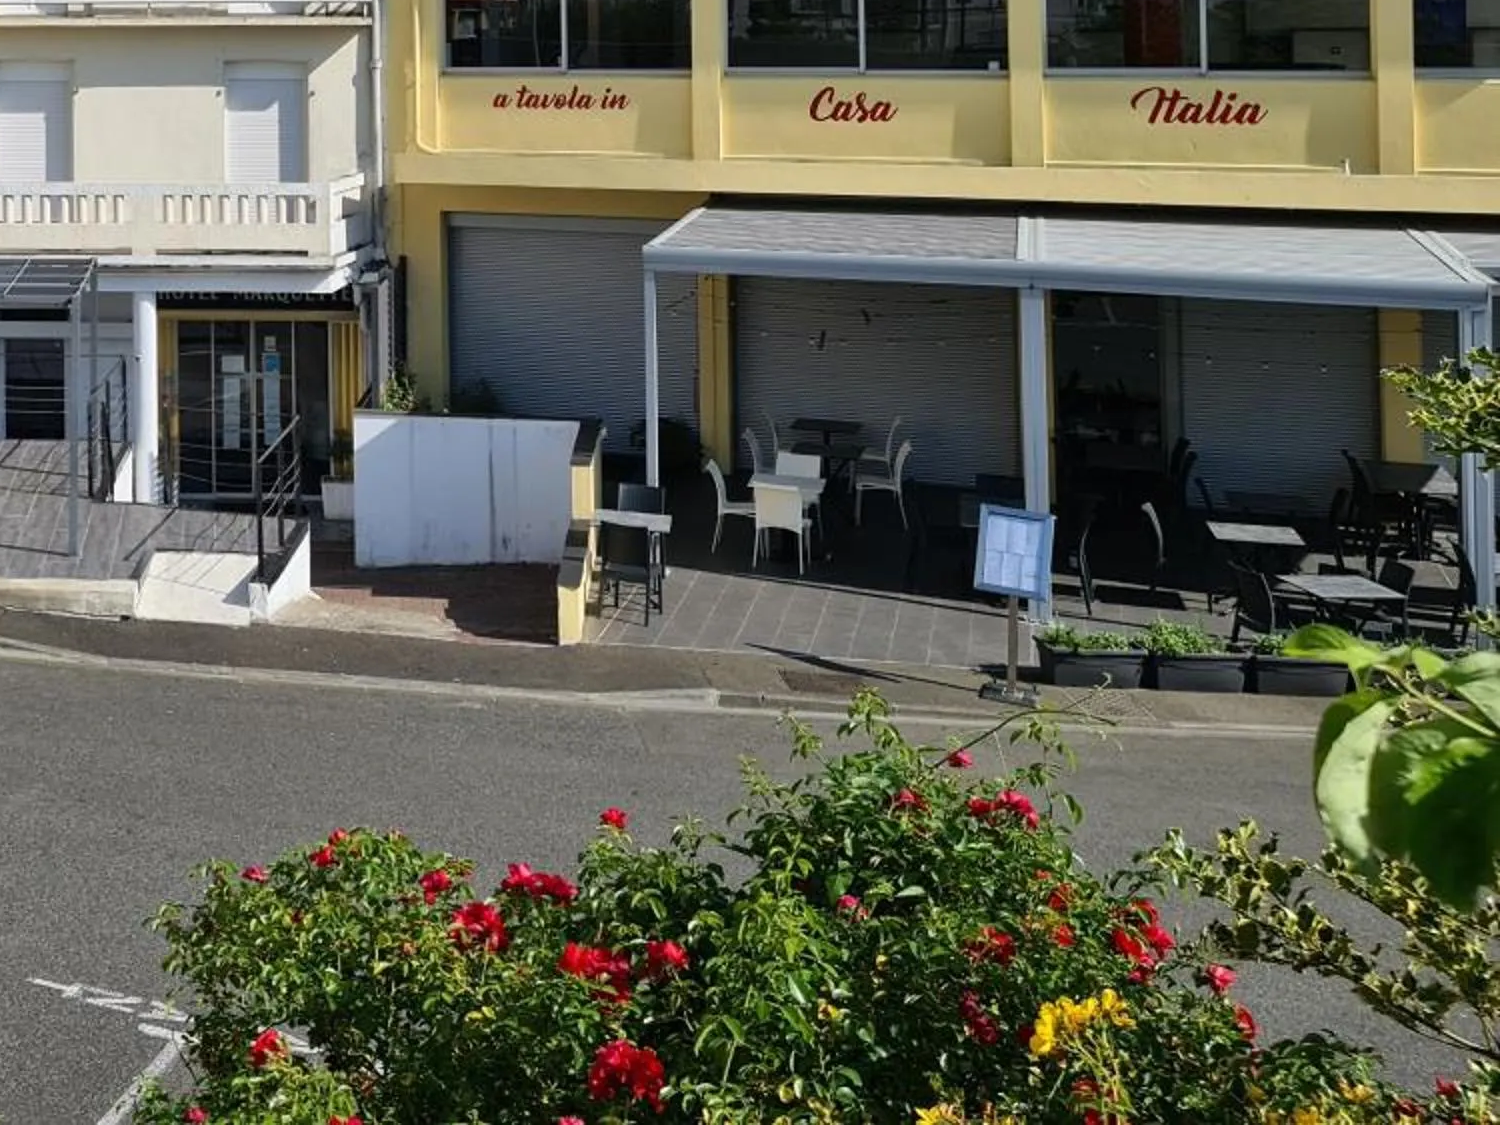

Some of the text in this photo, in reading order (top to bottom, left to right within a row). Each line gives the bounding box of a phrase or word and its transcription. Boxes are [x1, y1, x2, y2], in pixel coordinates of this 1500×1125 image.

[492, 84, 1269, 125] a tavola in Casa Italia
